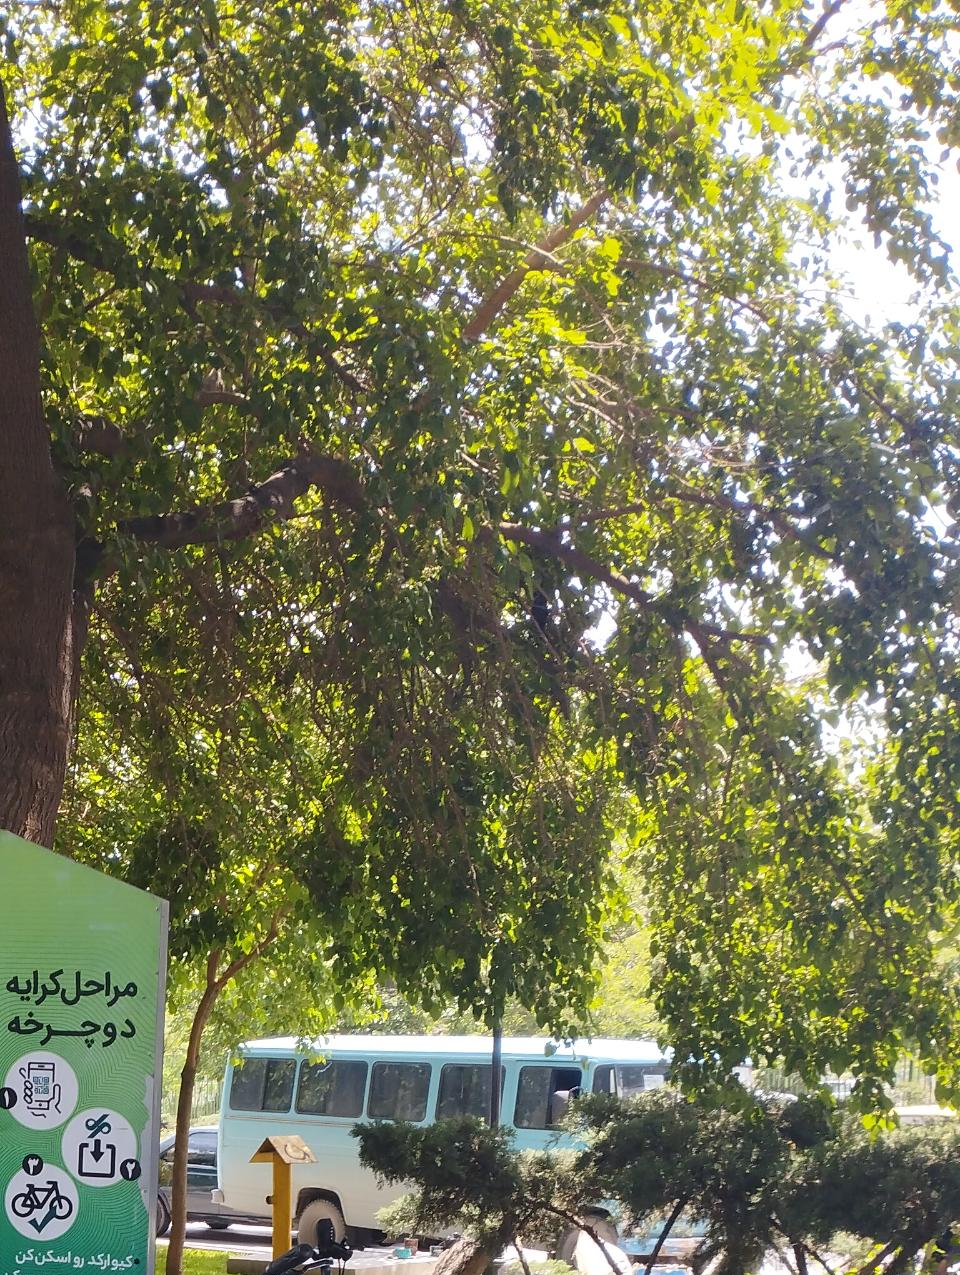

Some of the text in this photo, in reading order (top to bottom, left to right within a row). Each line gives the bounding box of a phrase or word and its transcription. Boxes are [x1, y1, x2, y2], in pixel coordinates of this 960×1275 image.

[6, 968, 138, 1007] مراحل کرایه
[7, 1011, 136, 1048] دوچرخه
[15, 1248, 35, 1264] کن
[34, 1249, 72, 1265] اسکن
[73, 1255, 85, 1268] رو
